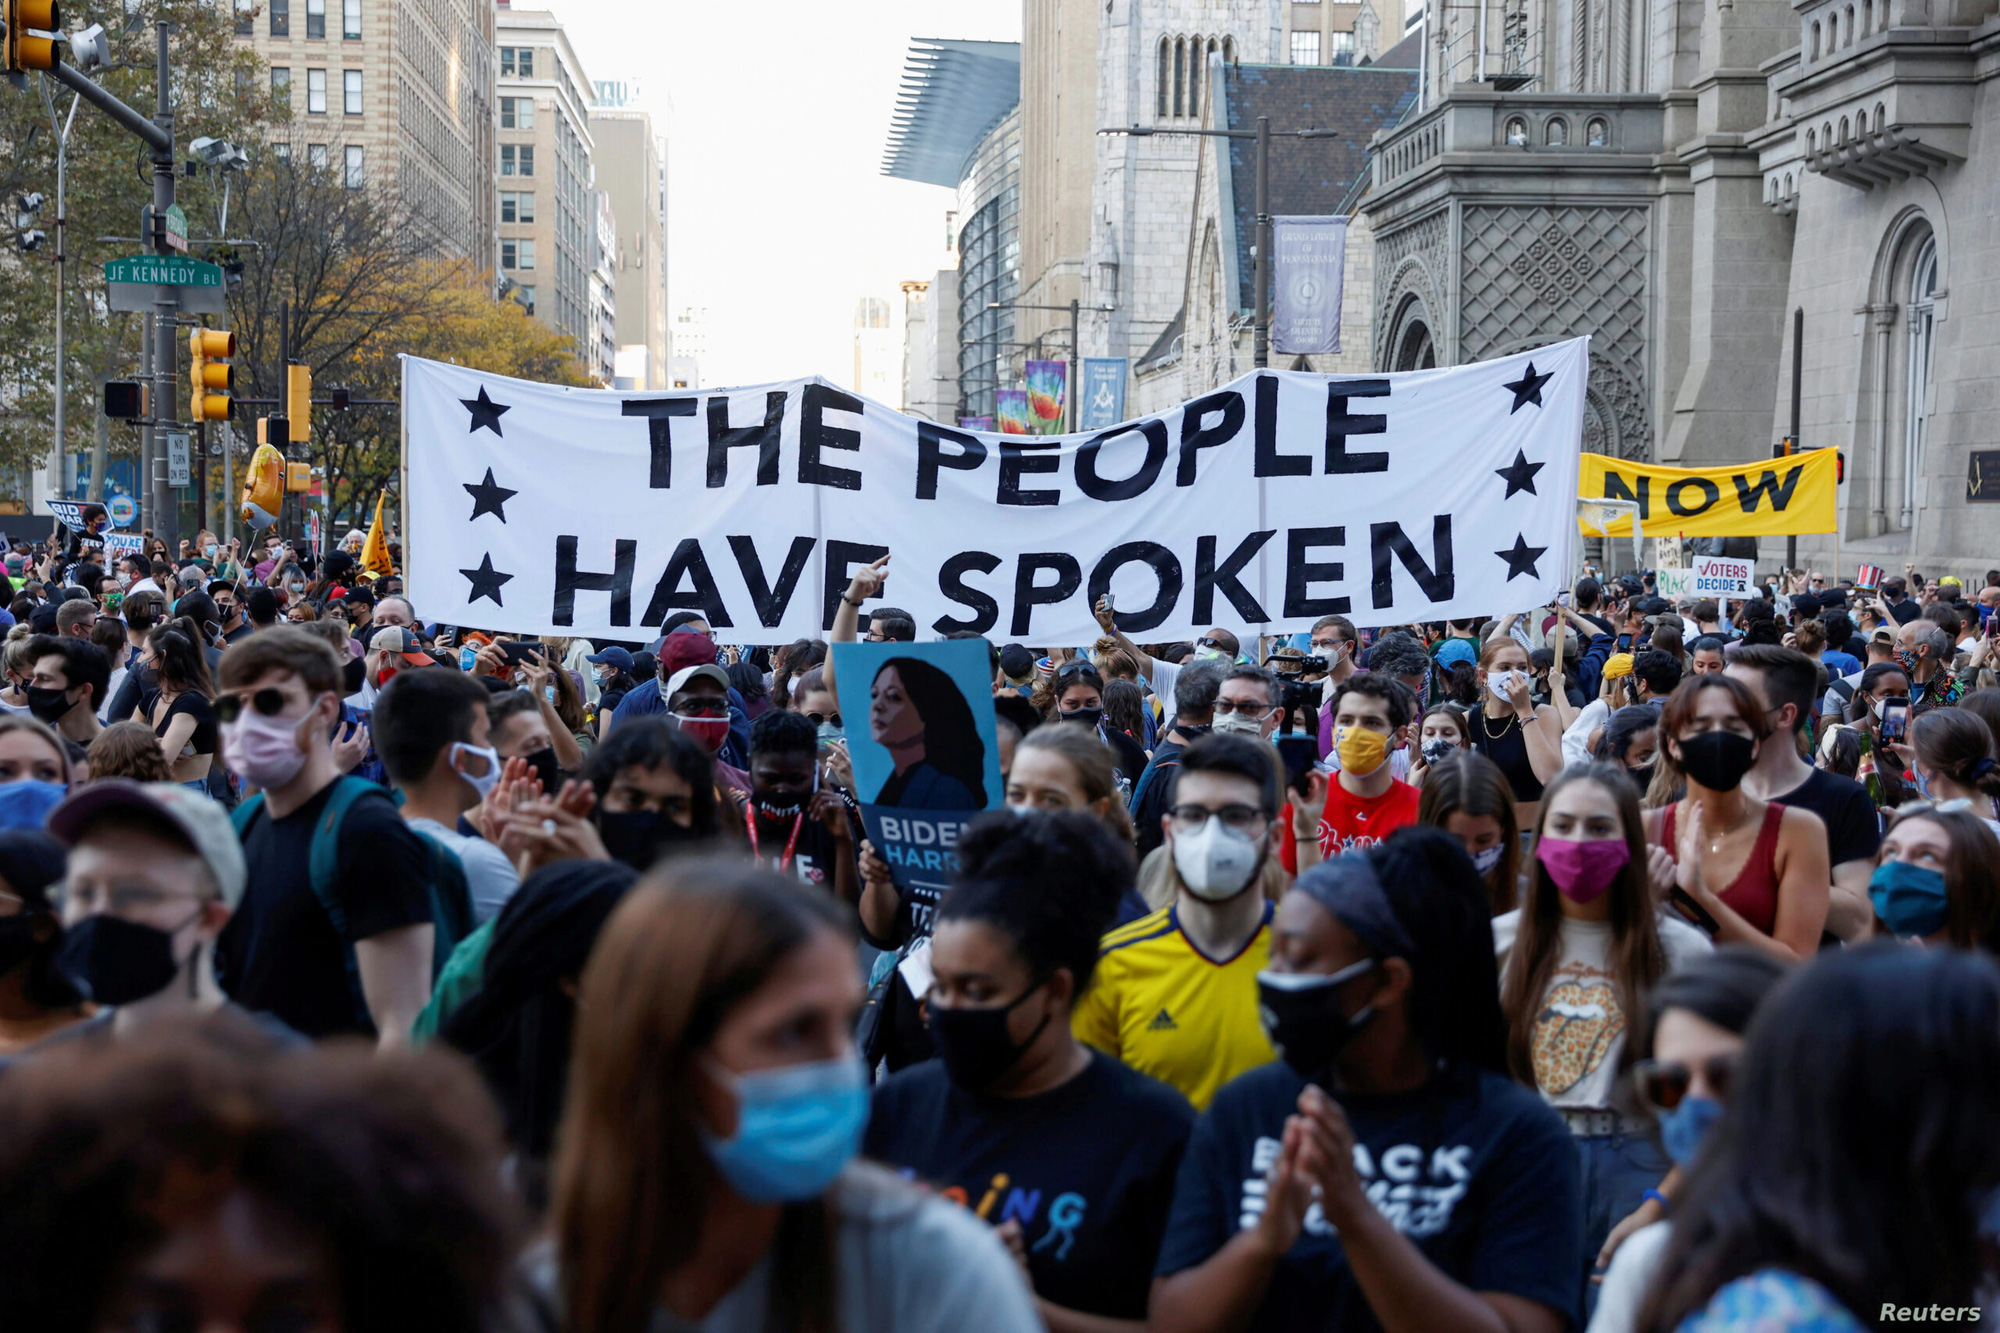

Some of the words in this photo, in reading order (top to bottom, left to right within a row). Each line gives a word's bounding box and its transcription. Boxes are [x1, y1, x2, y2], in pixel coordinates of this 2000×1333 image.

[109, 266, 125, 280] JF
[133, 266, 195, 283] KENNEDY
[204, 274, 217, 285] BL
[174, 439, 184, 450] NO
[621, 384, 864, 491] THE
[915, 375, 1391, 506] PEOPLE
[172, 454, 186, 465] TURN
[170, 469, 177, 480] ON
[178, 469, 188, 480] RED
[1604, 464, 1805, 520] NOW
[50, 503, 80, 516] BID
[57, 513, 84, 526] HAR
[553, 535, 889, 629] HAVE
[932, 514, 1455, 636] SPOKEN
[1698, 560, 1748, 578] VOTERS
[1697, 578, 1735, 591] DECIDE
[880, 816, 969, 847] BIDE
[884, 844, 962, 872] HARR
[1252, 1136, 1472, 1182] BACK
